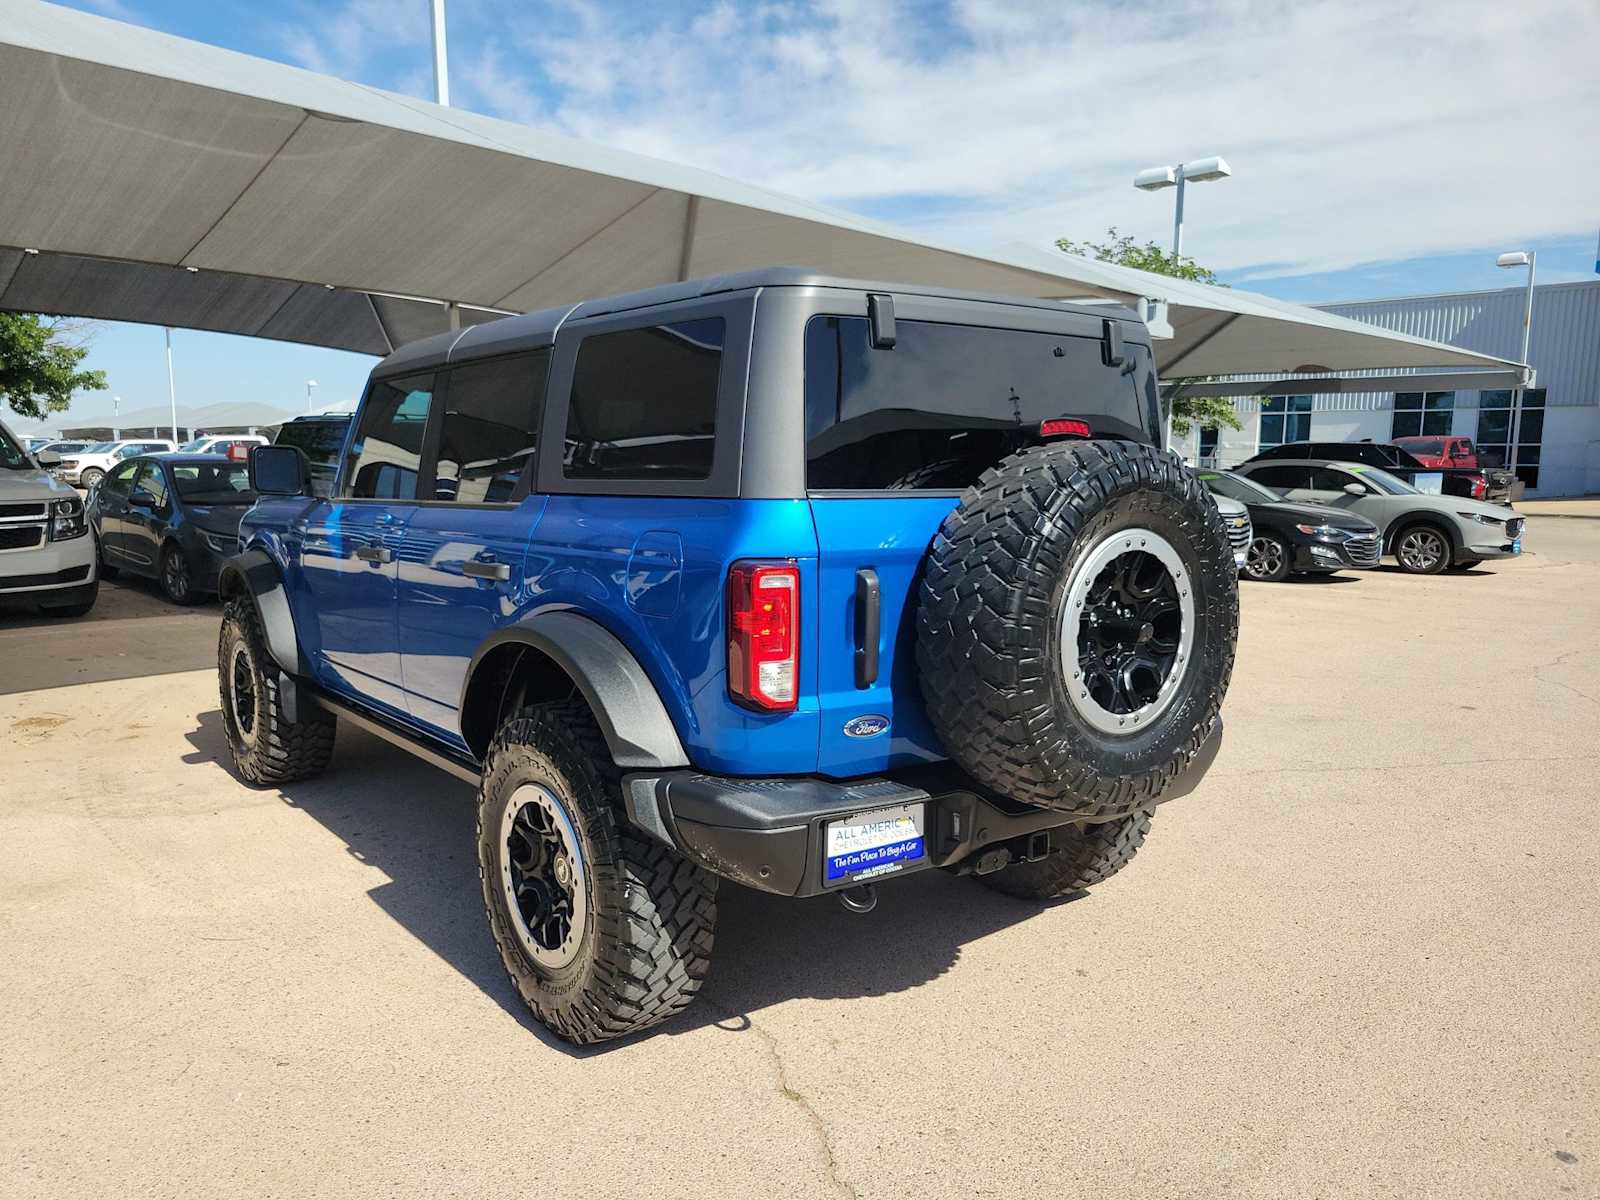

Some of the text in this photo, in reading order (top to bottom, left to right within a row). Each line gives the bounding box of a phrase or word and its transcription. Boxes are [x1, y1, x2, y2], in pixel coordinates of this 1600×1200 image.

[856, 721, 881, 734] Ford
[836, 828, 856, 841] ALL
[834, 857, 847, 868] The
[878, 848, 886, 858] To
[900, 844, 906, 853] A
